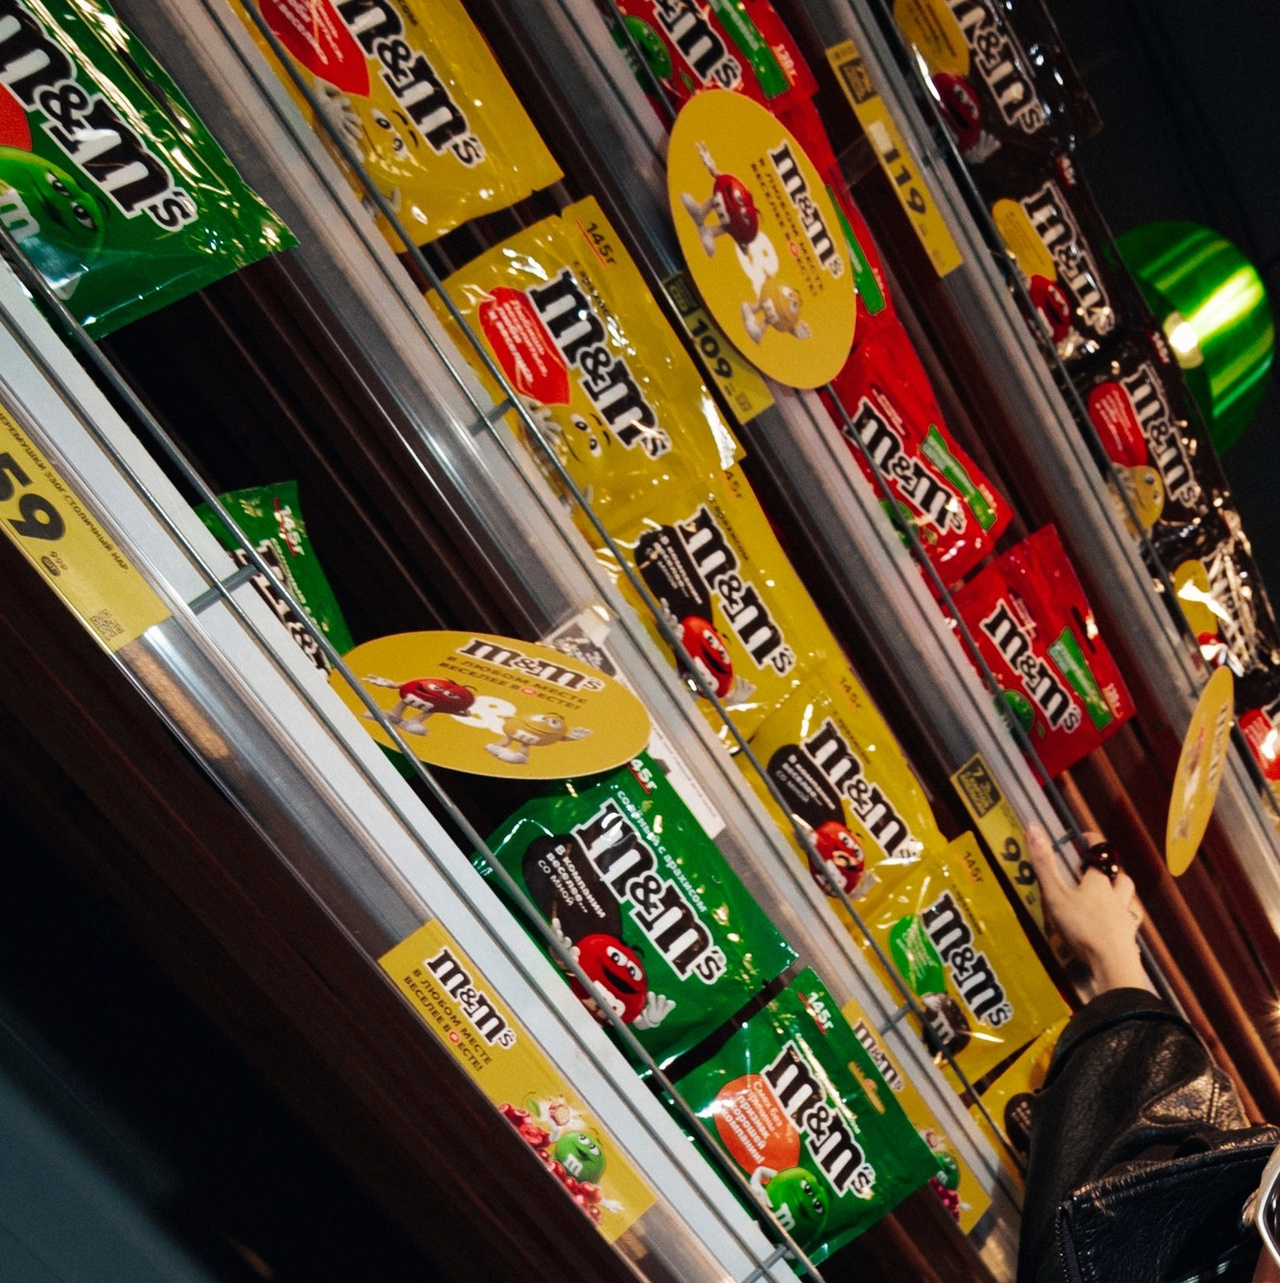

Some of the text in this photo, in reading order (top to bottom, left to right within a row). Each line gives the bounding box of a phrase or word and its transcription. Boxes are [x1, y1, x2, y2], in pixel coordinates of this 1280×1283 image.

[652, 0, 742, 90] m's
[586, 222, 617, 265] 145г
[767, 138, 844, 279] m&m's
[527, 266, 671, 460] m&m's
[691, 320, 733, 379] 109
[842, 396, 967, 535] m&m's
[674, 503, 796, 676] m&m's
[438, 661, 508, 686] ВЕСЕЛЕЕ
[455, 638, 605, 692] m&m's
[534, 682, 588, 704] МЕСТЕ
[979, 599, 1082, 733] m&m's
[630, 759, 657, 791] 45г
[562, 856, 607, 919] компании
[570, 798, 727, 984] m&m's
[663, 853, 709, 914] арахисом
[1000, 837, 1037, 886] 99
[920, 889, 1013, 1029] m&m's
[403, 975, 445, 1025] ВЕСЕЛЕЕ
[420, 979, 461, 1027] ЛЮБОМ
[461, 1026, 493, 1066] МЕСТЕ
[424, 947, 516, 1049] m&m's
[808, 992, 834, 1031] 145г
[760, 1040, 875, 1199] m&m's
